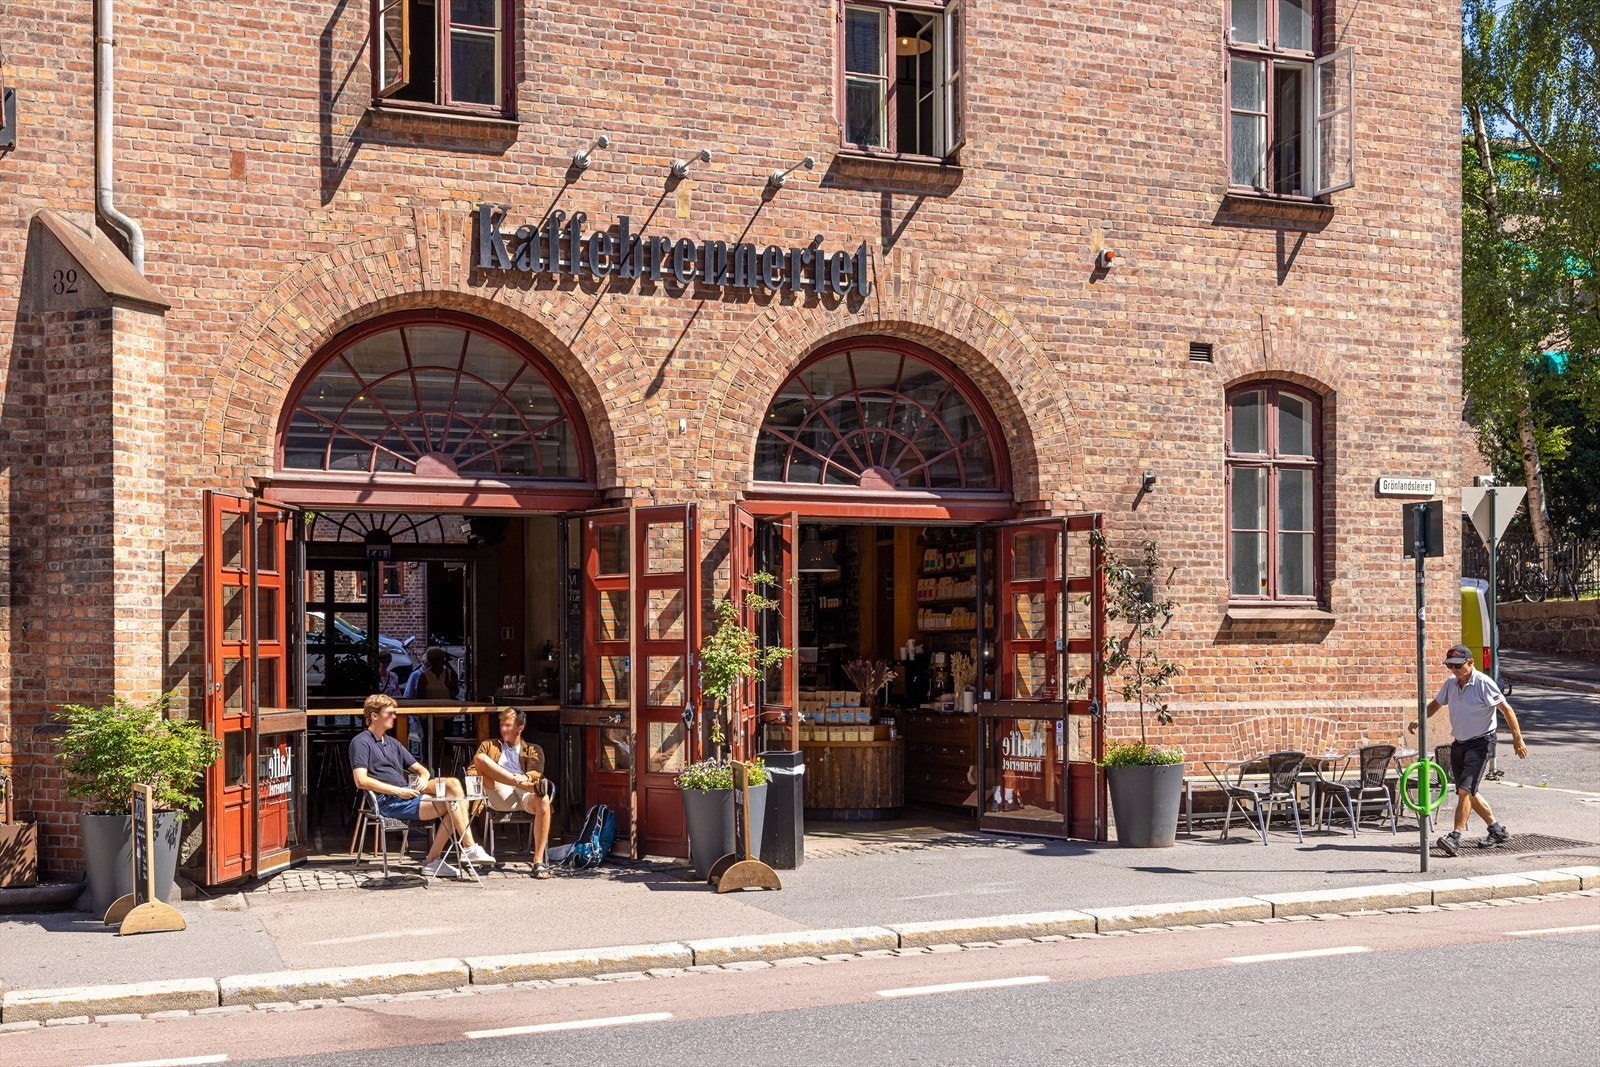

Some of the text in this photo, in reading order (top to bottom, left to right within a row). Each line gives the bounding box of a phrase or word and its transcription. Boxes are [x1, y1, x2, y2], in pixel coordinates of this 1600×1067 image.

[476, 203, 873, 298] Kaffebrenneriet
[53, 269, 78, 295] 32
[1383, 480, 1432, 492] Grönlandsleiret
